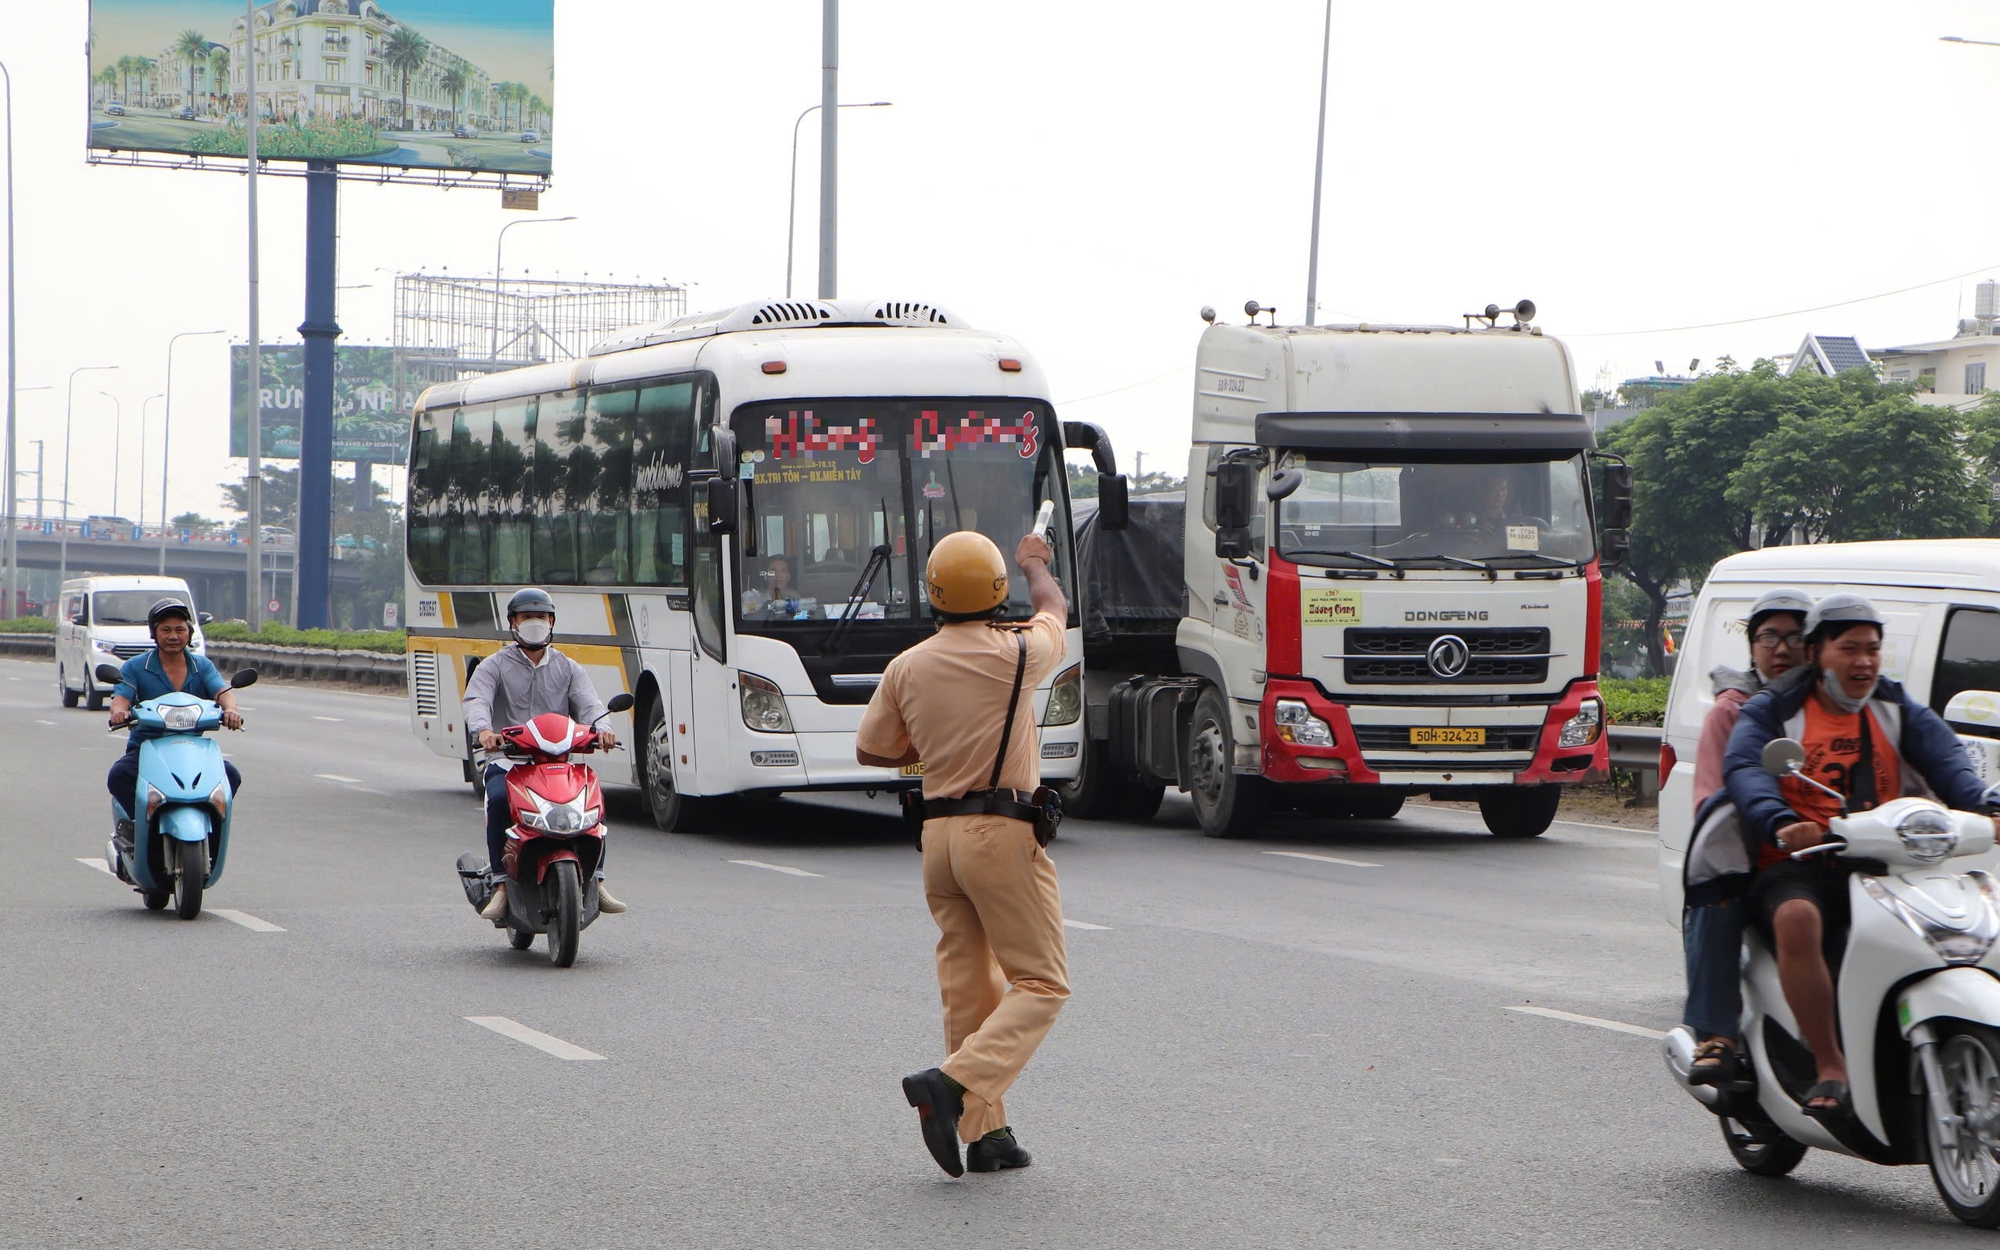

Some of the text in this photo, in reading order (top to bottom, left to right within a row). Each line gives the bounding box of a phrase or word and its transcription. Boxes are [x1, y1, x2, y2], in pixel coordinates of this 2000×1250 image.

[845, 467, 862, 481] TÂY
[1405, 611, 1489, 621] DONGFENG
[1417, 731, 1479, 742] 50H-324.23
